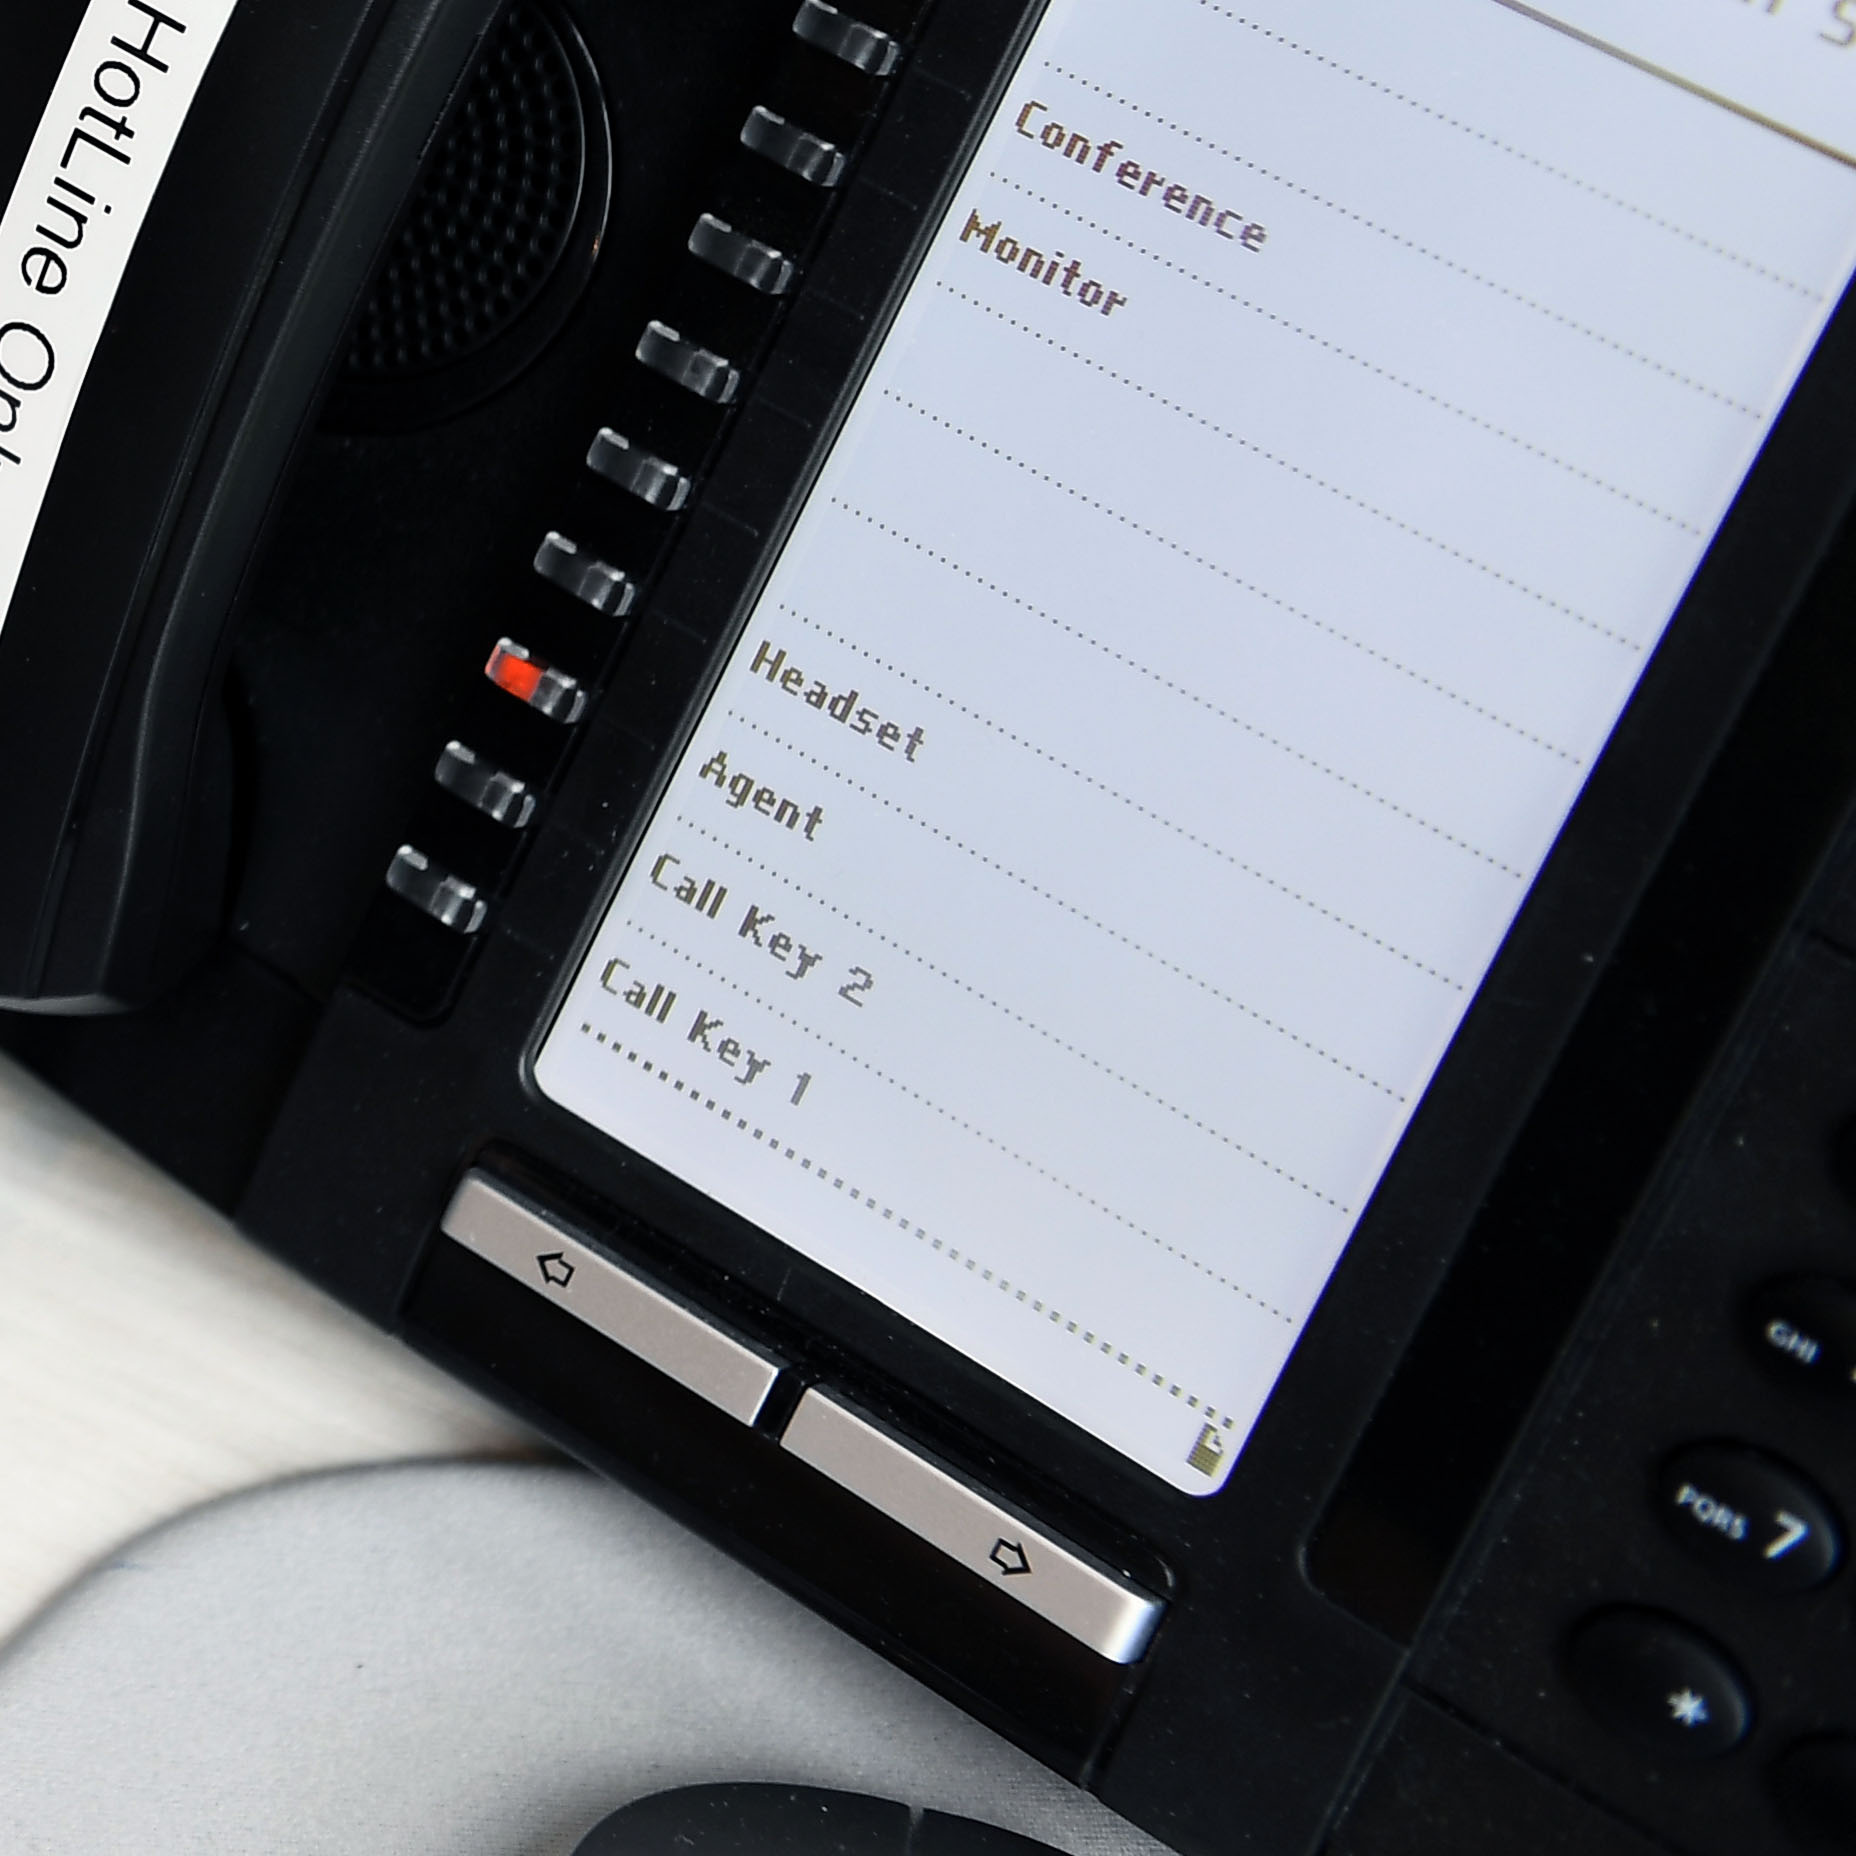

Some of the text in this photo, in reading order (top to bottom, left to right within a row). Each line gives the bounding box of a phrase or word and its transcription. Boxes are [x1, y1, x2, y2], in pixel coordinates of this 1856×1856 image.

[1014, 100, 1268, 254] Conference
[959, 208, 1128, 317] Monitor
[749, 639, 926, 763] Headset
[697, 750, 825, 842] Agent
[649, 852, 875, 1008] Call Key 2
[599, 956, 812, 1107] Call Key 1
[1675, 1482, 1810, 1561] PQRS 7
